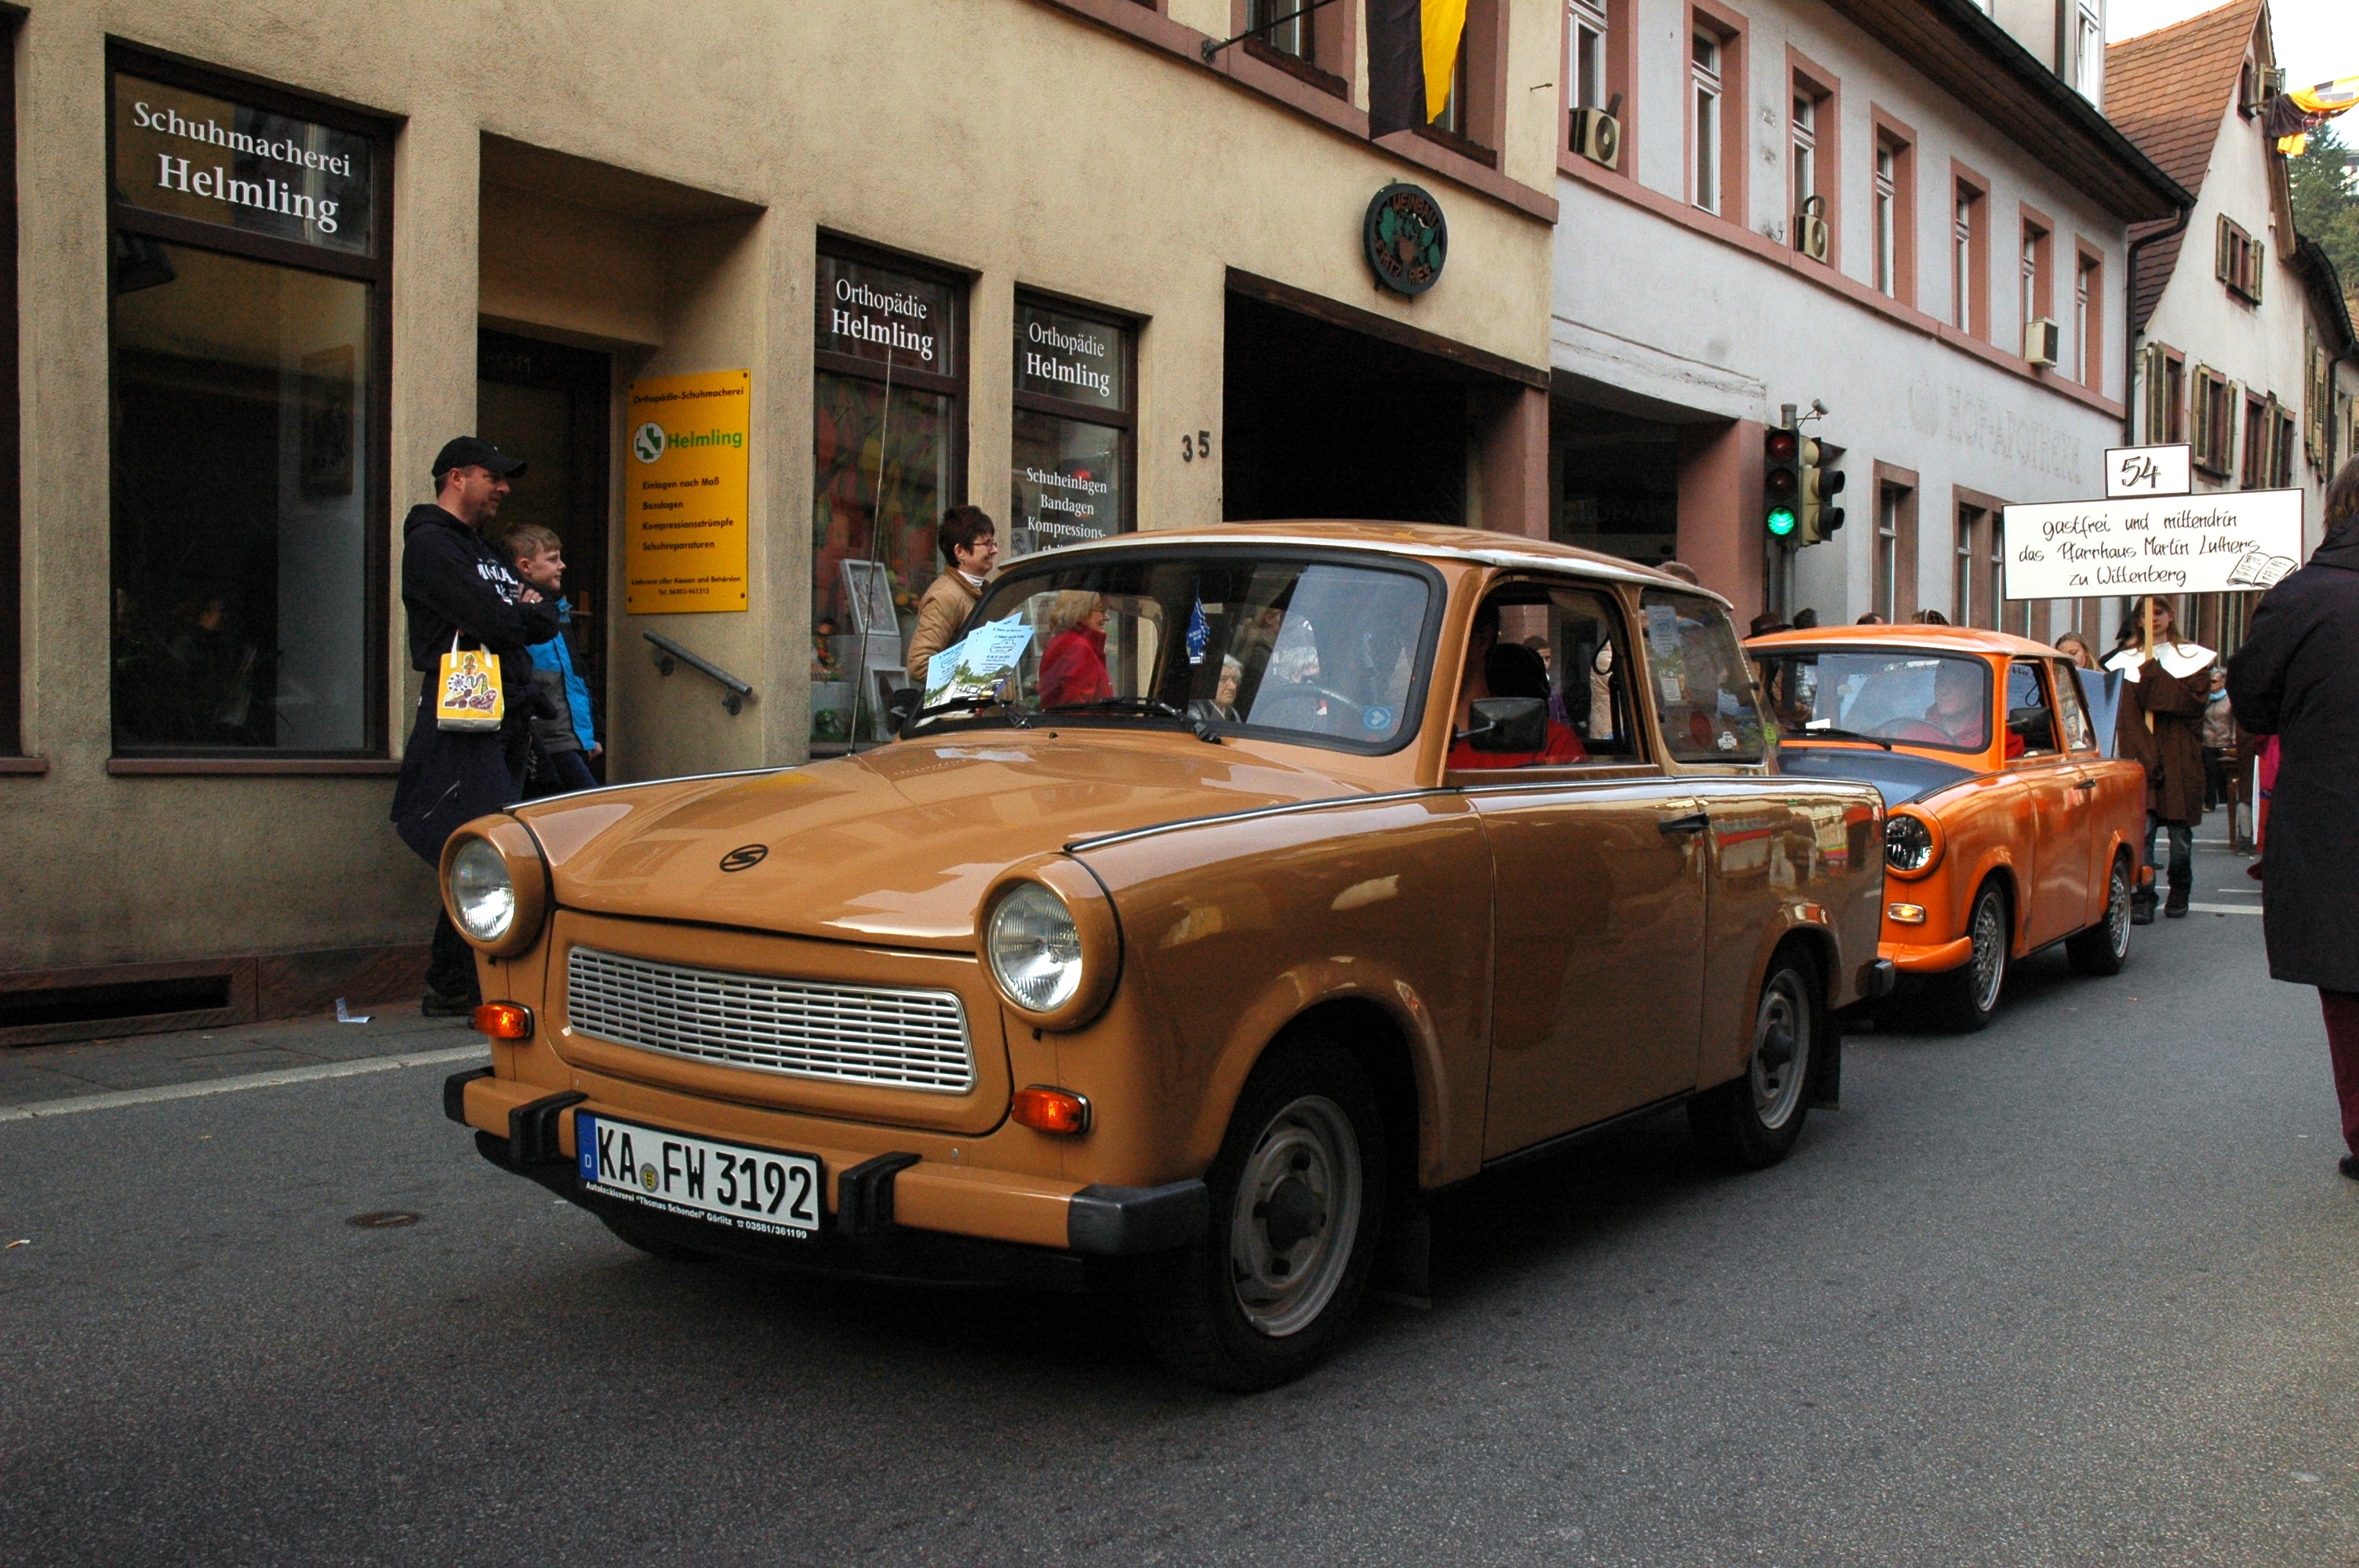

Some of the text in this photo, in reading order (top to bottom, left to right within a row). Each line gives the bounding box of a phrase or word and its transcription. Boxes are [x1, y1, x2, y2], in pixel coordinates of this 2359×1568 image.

[133, 101, 351, 178] Schuhmacherei
[158, 153, 340, 234] Helmling
[835, 278, 928, 320] Orthopädie
[831, 307, 934, 361] Helmling
[1029, 321, 1105, 358] Orthopädie
[1026, 351, 1110, 397] Helmling
[634, 387, 744, 405] Orthopädie-Schuhmacherei
[667, 428, 743, 449] Helmling
[1181, 430, 1210, 463] 35
[642, 476, 720, 491] Einlagen nach Maß
[1027, 467, 1107, 495] Schuheinlagen
[2120, 455, 2162, 490] 54
[642, 500, 684, 511] Bandagen
[1040, 493, 1095, 517] Bandagen
[642, 517, 734, 532] Kompressionsstrümpfe
[1027, 516, 1107, 539] Kompressions-
[2042, 506, 2237, 542] gastfrei und mittendrin
[642, 540, 715, 552] Schuhreparaturen
[2019, 535, 2261, 566] das Pfarrhaus Martin Luthers
[2069, 564, 2187, 588] zu Wittenberg
[584, 1153, 592, 1169] D
[597, 1125, 813, 1221] KA FW 3192
[707, 1212, 732, 1226] Görlitz
